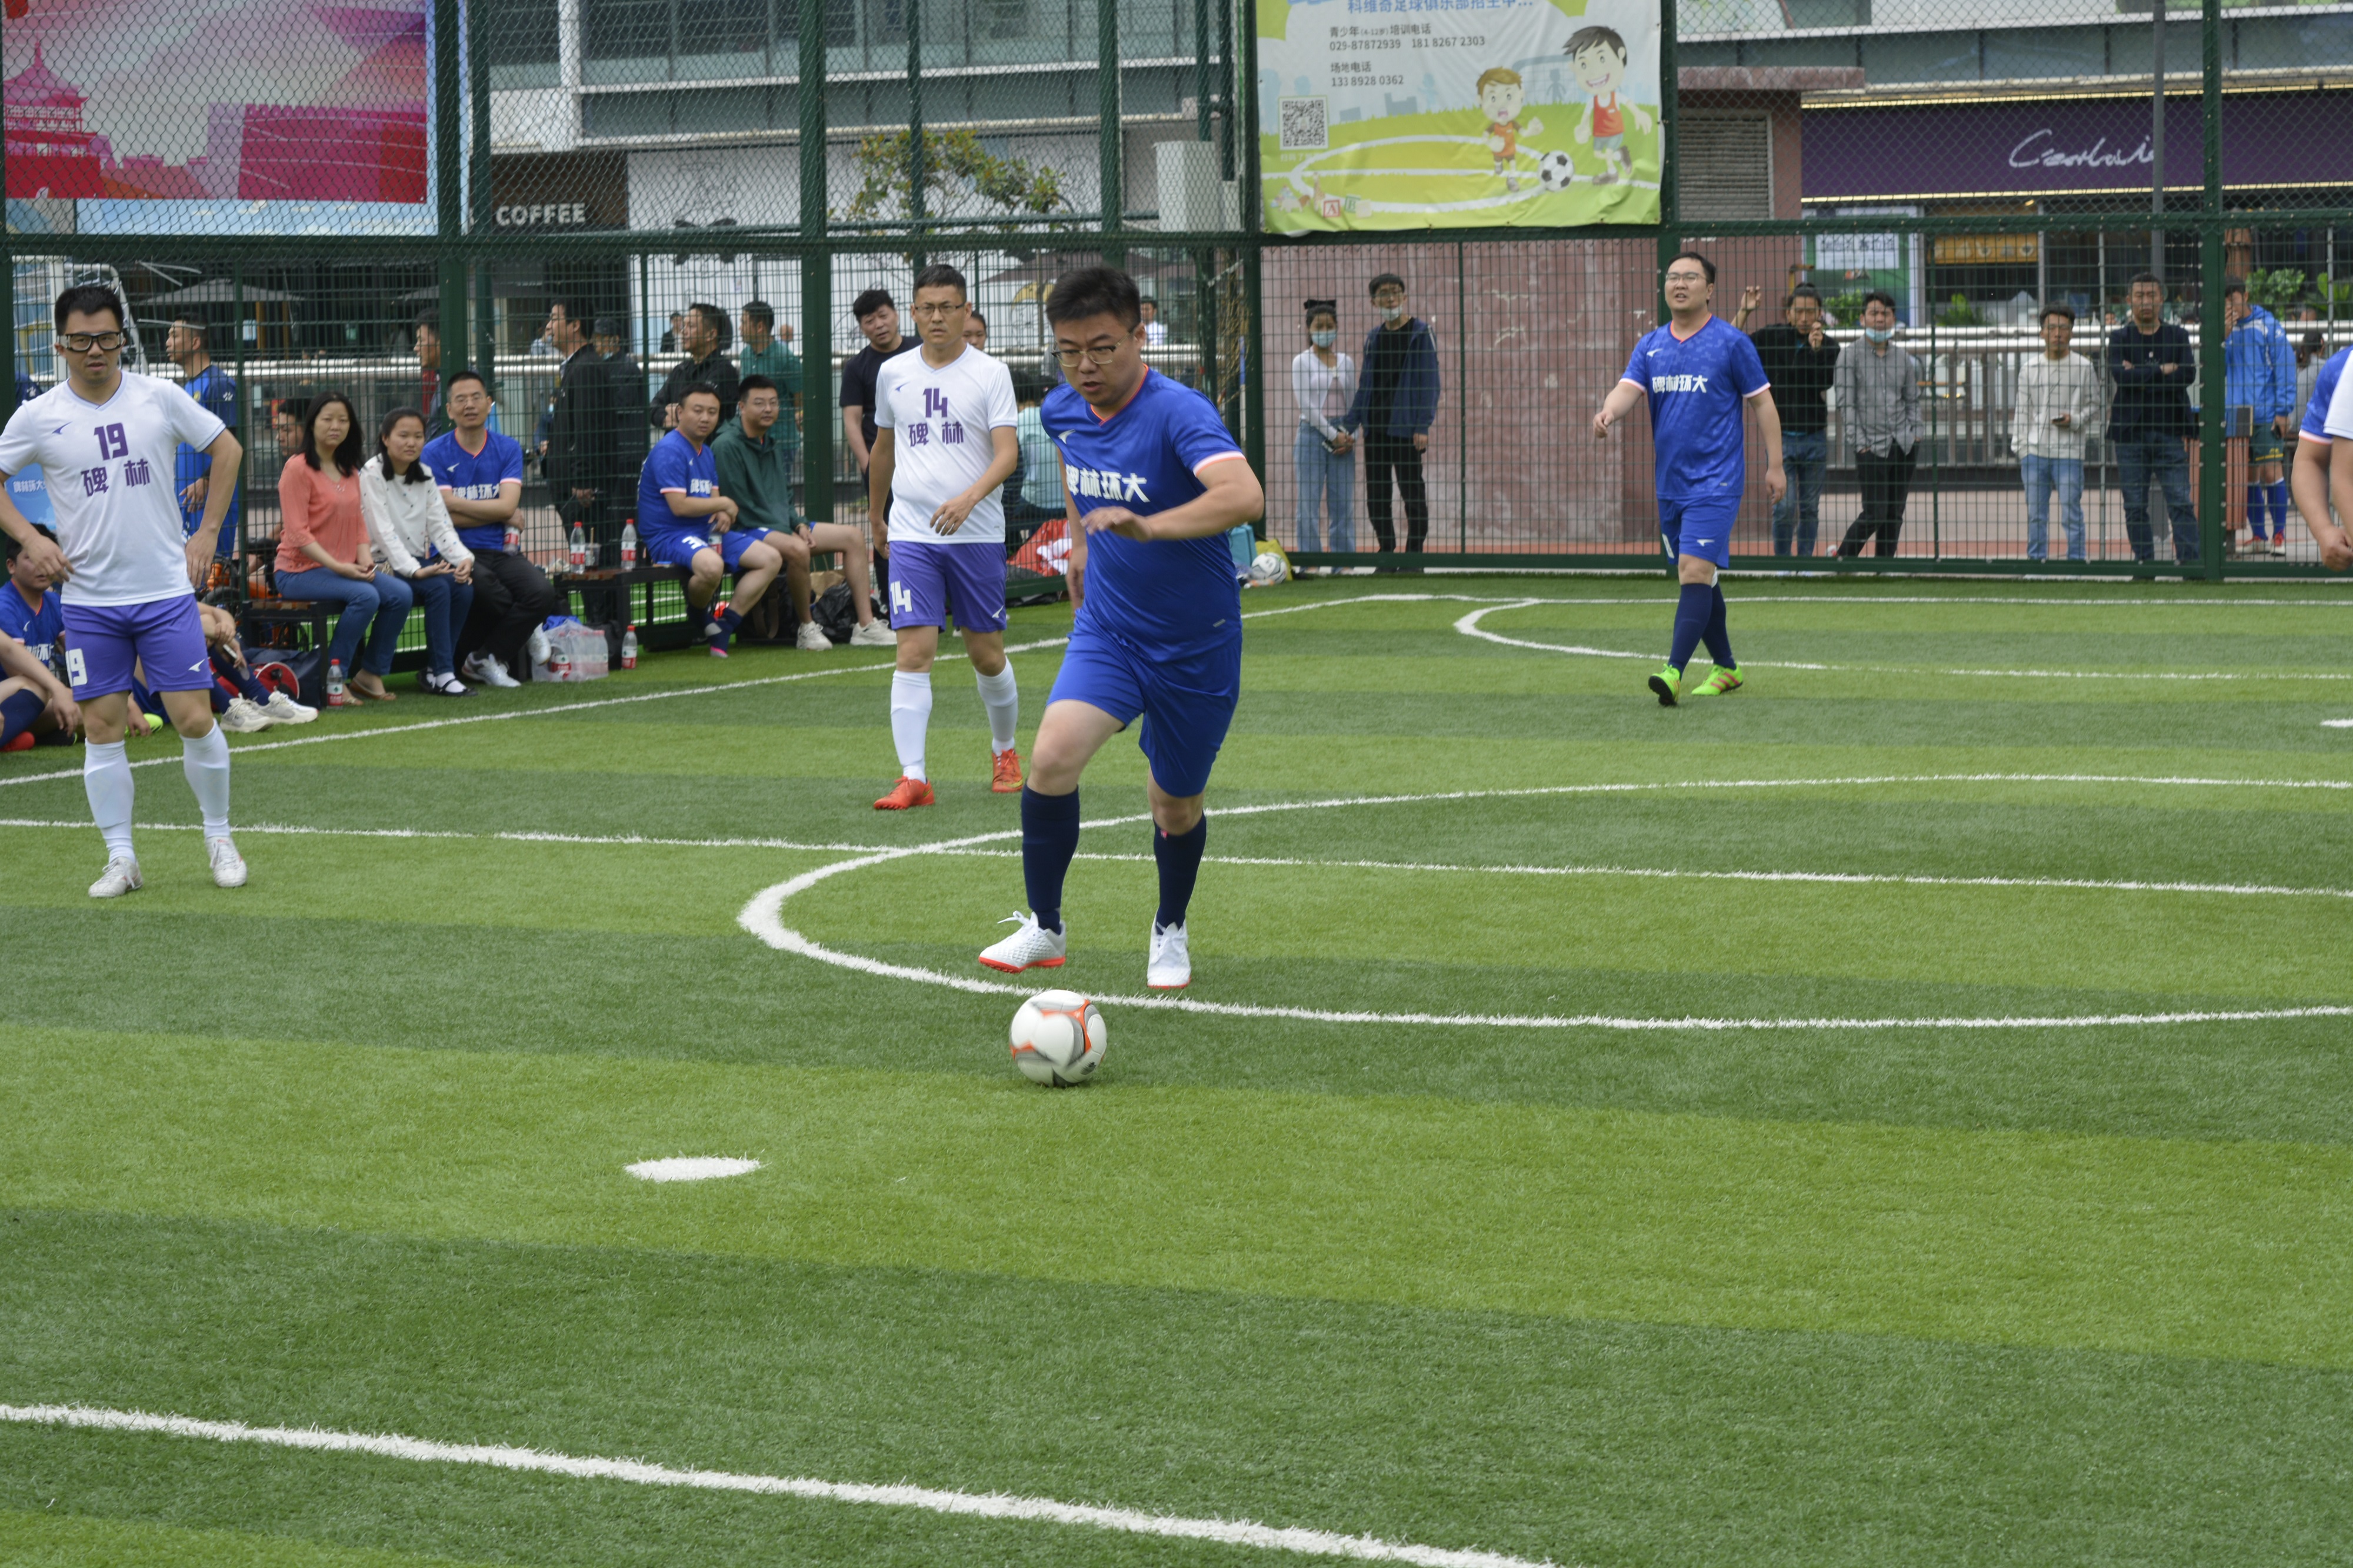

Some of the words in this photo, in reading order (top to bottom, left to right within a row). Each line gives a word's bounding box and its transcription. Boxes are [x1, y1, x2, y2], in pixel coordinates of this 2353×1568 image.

[1329, 39, 1401, 51] 029-87872939
[1412, 38, 1429, 48] 181
[1432, 37, 1457, 48] 8267
[1460, 36, 1486, 46] 2303
[1330, 61, 1372, 74] 场地电话
[1331, 77, 1348, 87] 133
[1351, 76, 1377, 86] 8928
[1379, 75, 1405, 86] 0362
[496, 202, 585, 226] COFFEE
[1652, 374, 1708, 393] 碑林环大
[922, 388, 948, 418] 14
[94, 422, 129, 461] 19
[908, 422, 929, 447] 碑
[941, 421, 964, 445] 林
[13, 479, 46, 493] 碑林环大
[81, 466, 109, 497] 碑
[124, 458, 151, 488] 林
[890, 580, 912, 615] 14
[65, 648, 88, 688] 19
